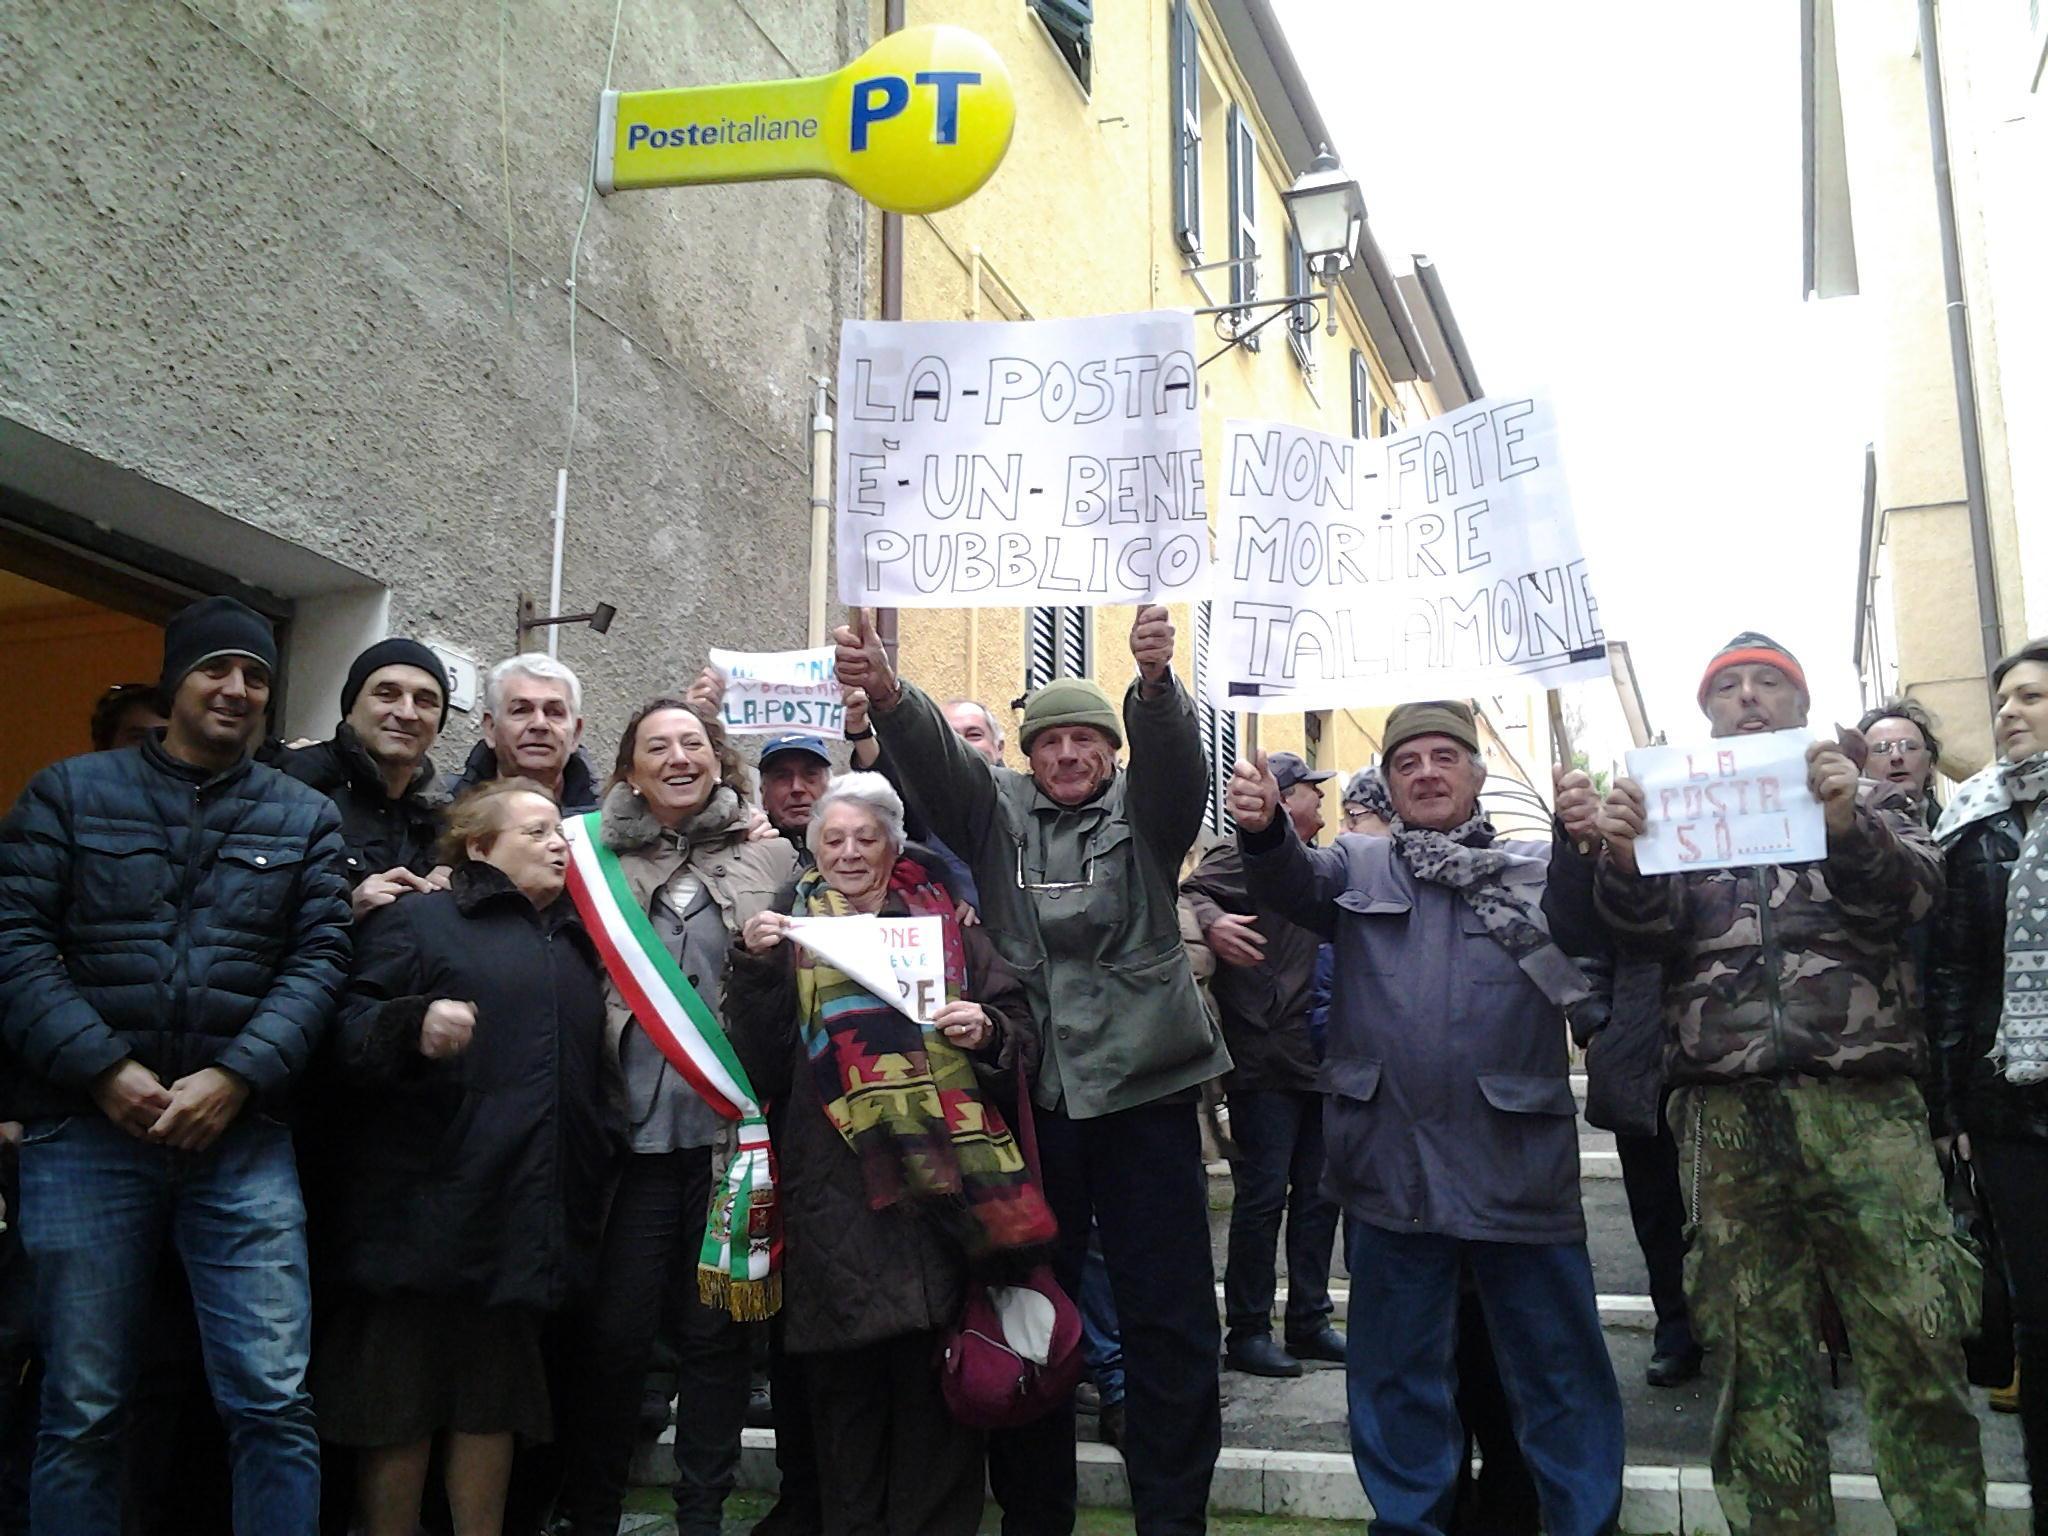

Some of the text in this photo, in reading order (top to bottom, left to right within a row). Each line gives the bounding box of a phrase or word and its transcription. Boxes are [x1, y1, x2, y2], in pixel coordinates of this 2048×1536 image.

[628, 114, 818, 150] Posteitaliane
[850, 71, 981, 154] PT
[864, 530, 1201, 593] PUBBLICO
[1233, 557, 1606, 680] TALAMONE
